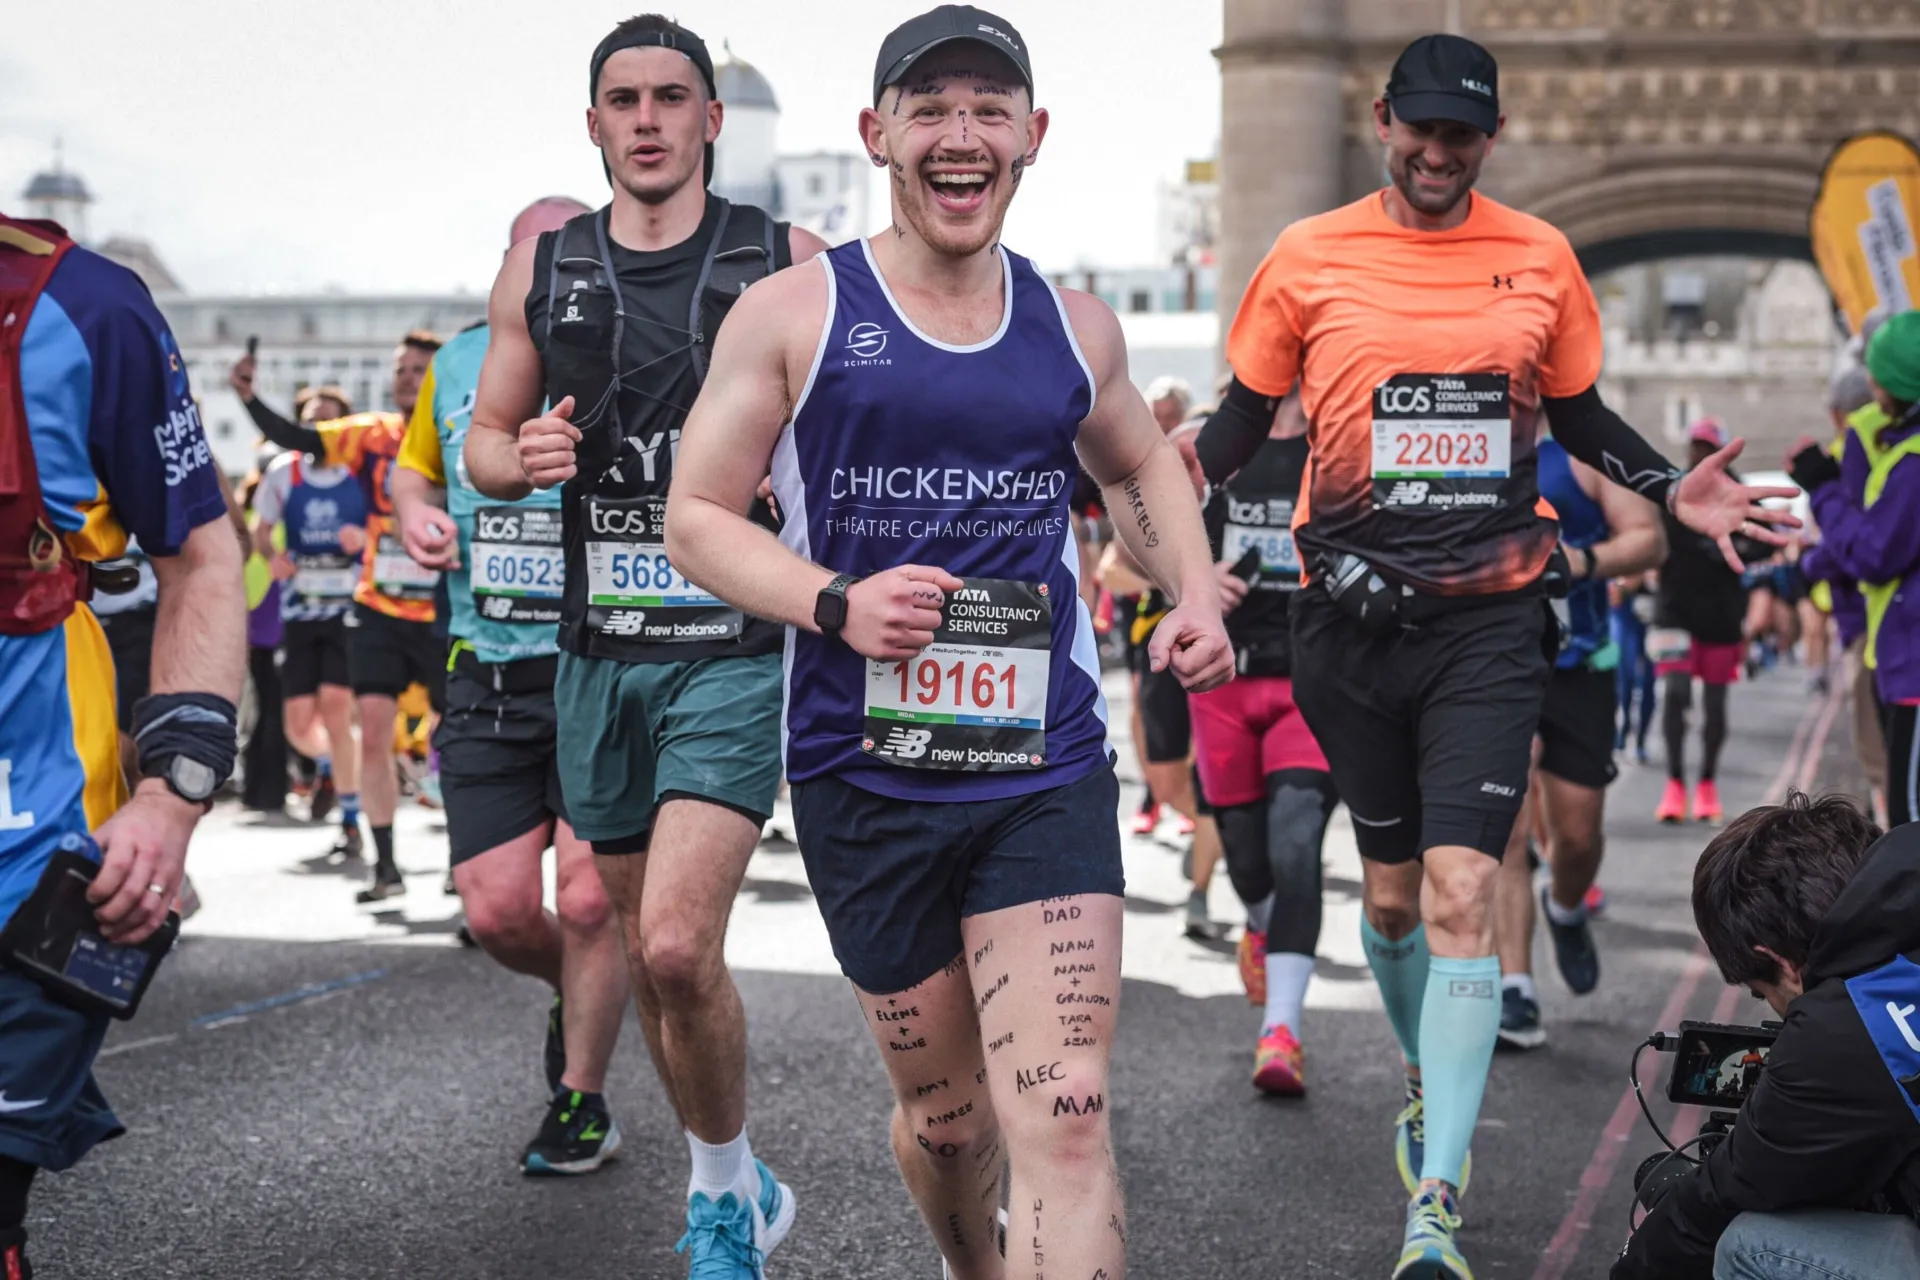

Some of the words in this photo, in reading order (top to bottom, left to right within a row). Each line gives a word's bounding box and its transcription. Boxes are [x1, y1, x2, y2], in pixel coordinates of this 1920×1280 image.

[958, 110, 968, 142] MIKE
[844, 358, 892, 368] SCIMITAR
[1380, 386, 1431, 413] tcs
[1436, 380, 1466, 390] TATA
[1435, 391, 1503, 402] CONSULTANCY
[1435, 403, 1479, 413] SERVICES
[1395, 433, 1489, 466] 22023
[830, 466, 1065, 500] CHICKENSHED
[1428, 493, 1453, 505] new
[479, 511, 519, 540] tcs
[590, 501, 645, 534] tcs
[826, 516, 901, 537] THEATRE
[908, 519, 1023, 538] CHANGING
[1027, 517, 1064, 536] LIVES
[487, 555, 565, 586] 60523
[953, 588, 991, 602] TATA
[950, 604, 1041, 621] CONSULTANCY
[645, 625, 672, 635] new
[674, 624, 728, 636] balance
[949, 620, 1008, 634] SERVICES
[894, 659, 1016, 709] 19161
[897, 711, 915, 719] MEDAL
[931, 749, 965, 762] new
[968, 748, 1028, 764] balance
[1044, 906, 1081, 924] DAD
[1050, 939, 1094, 956] NANA
[1054, 964, 1096, 976] NANA
[1056, 992, 1110, 1006] GRANDPA
[1058, 1014, 1092, 1025] TARA
[1063, 1037, 1096, 1046] SEAN
[917, 1077, 949, 1096] AMY
[1016, 1062, 1067, 1094] ALEC
